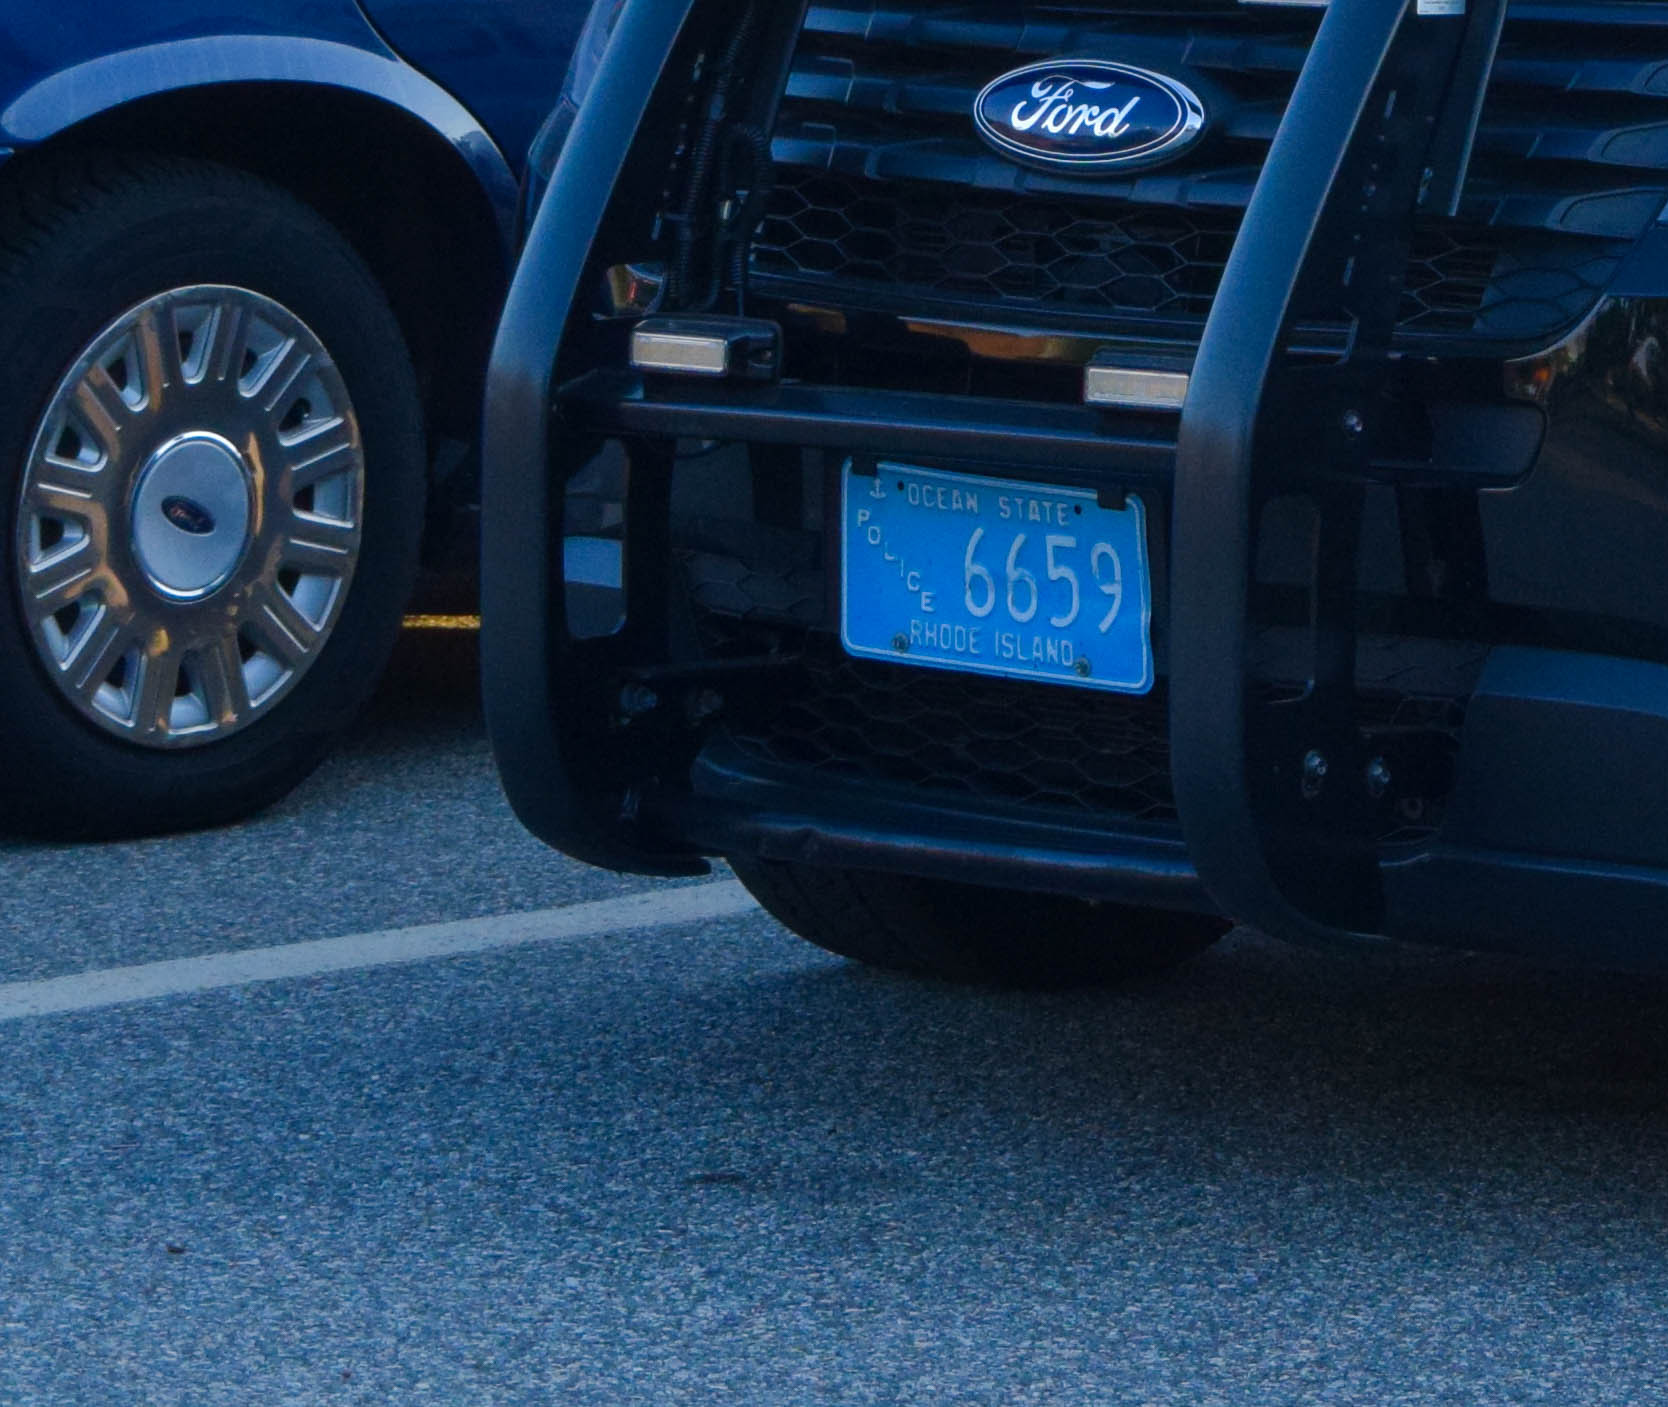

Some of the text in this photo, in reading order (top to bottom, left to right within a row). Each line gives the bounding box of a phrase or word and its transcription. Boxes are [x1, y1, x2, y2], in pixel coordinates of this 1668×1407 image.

[1011, 75, 1141, 138] Ford
[907, 482, 1070, 527] OCEAN STATE
[857, 507, 937, 613] POLICE
[964, 527, 1122, 634] 6659
[910, 619, 1075, 669] RHODE ISLAND
